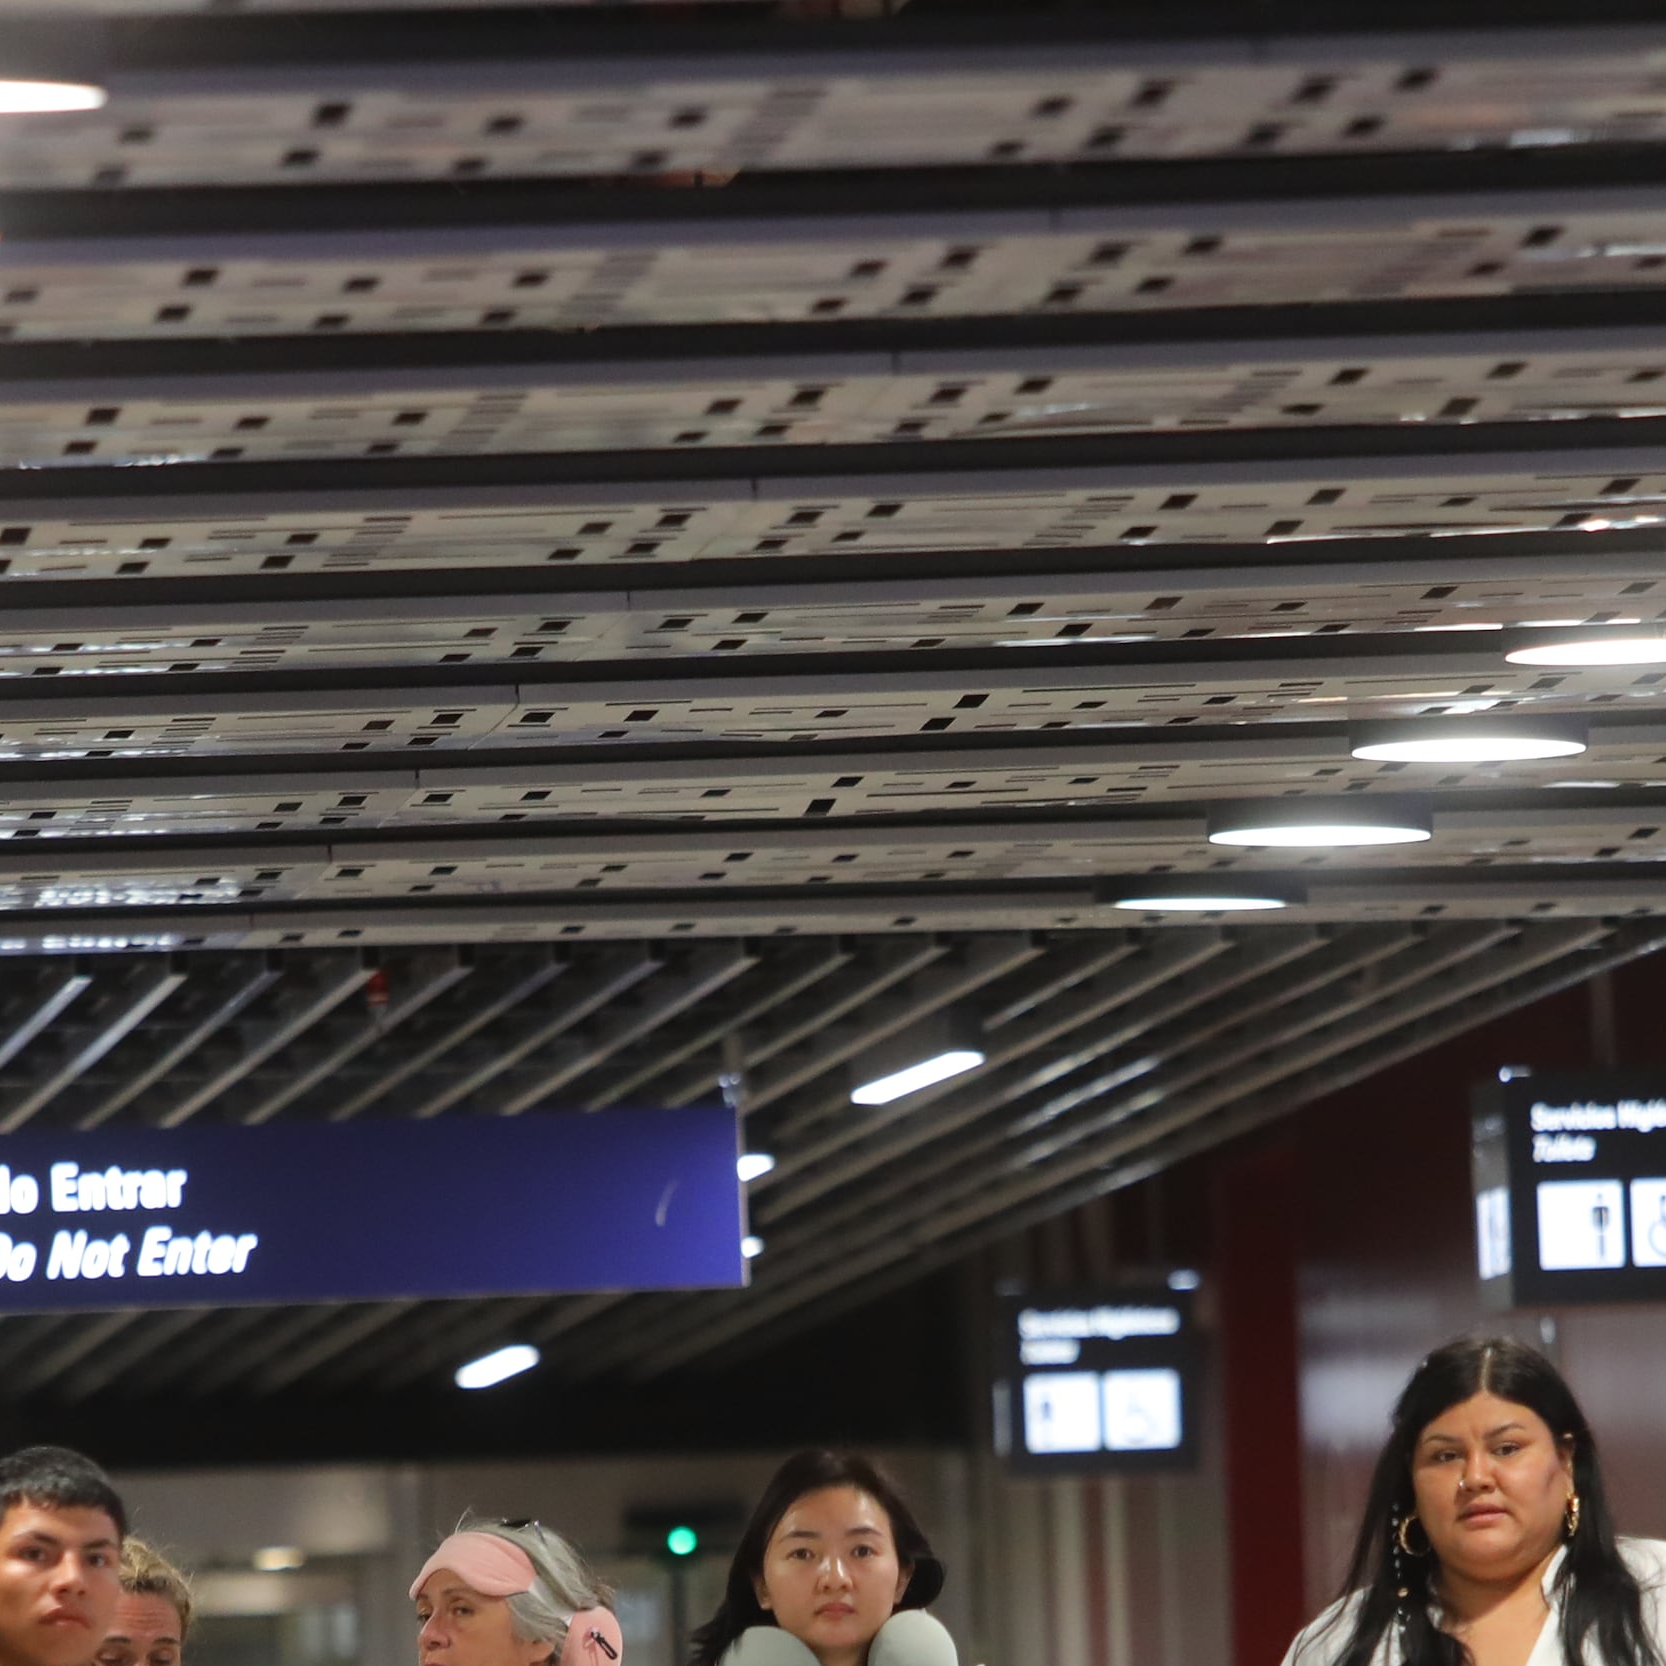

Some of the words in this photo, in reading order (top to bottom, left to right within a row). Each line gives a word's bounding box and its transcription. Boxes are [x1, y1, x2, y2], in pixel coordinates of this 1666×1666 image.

[50, 1162, 188, 1213] Entrar
[46, 1229, 131, 1281] Not
[137, 1226, 259, 1278] Enter
